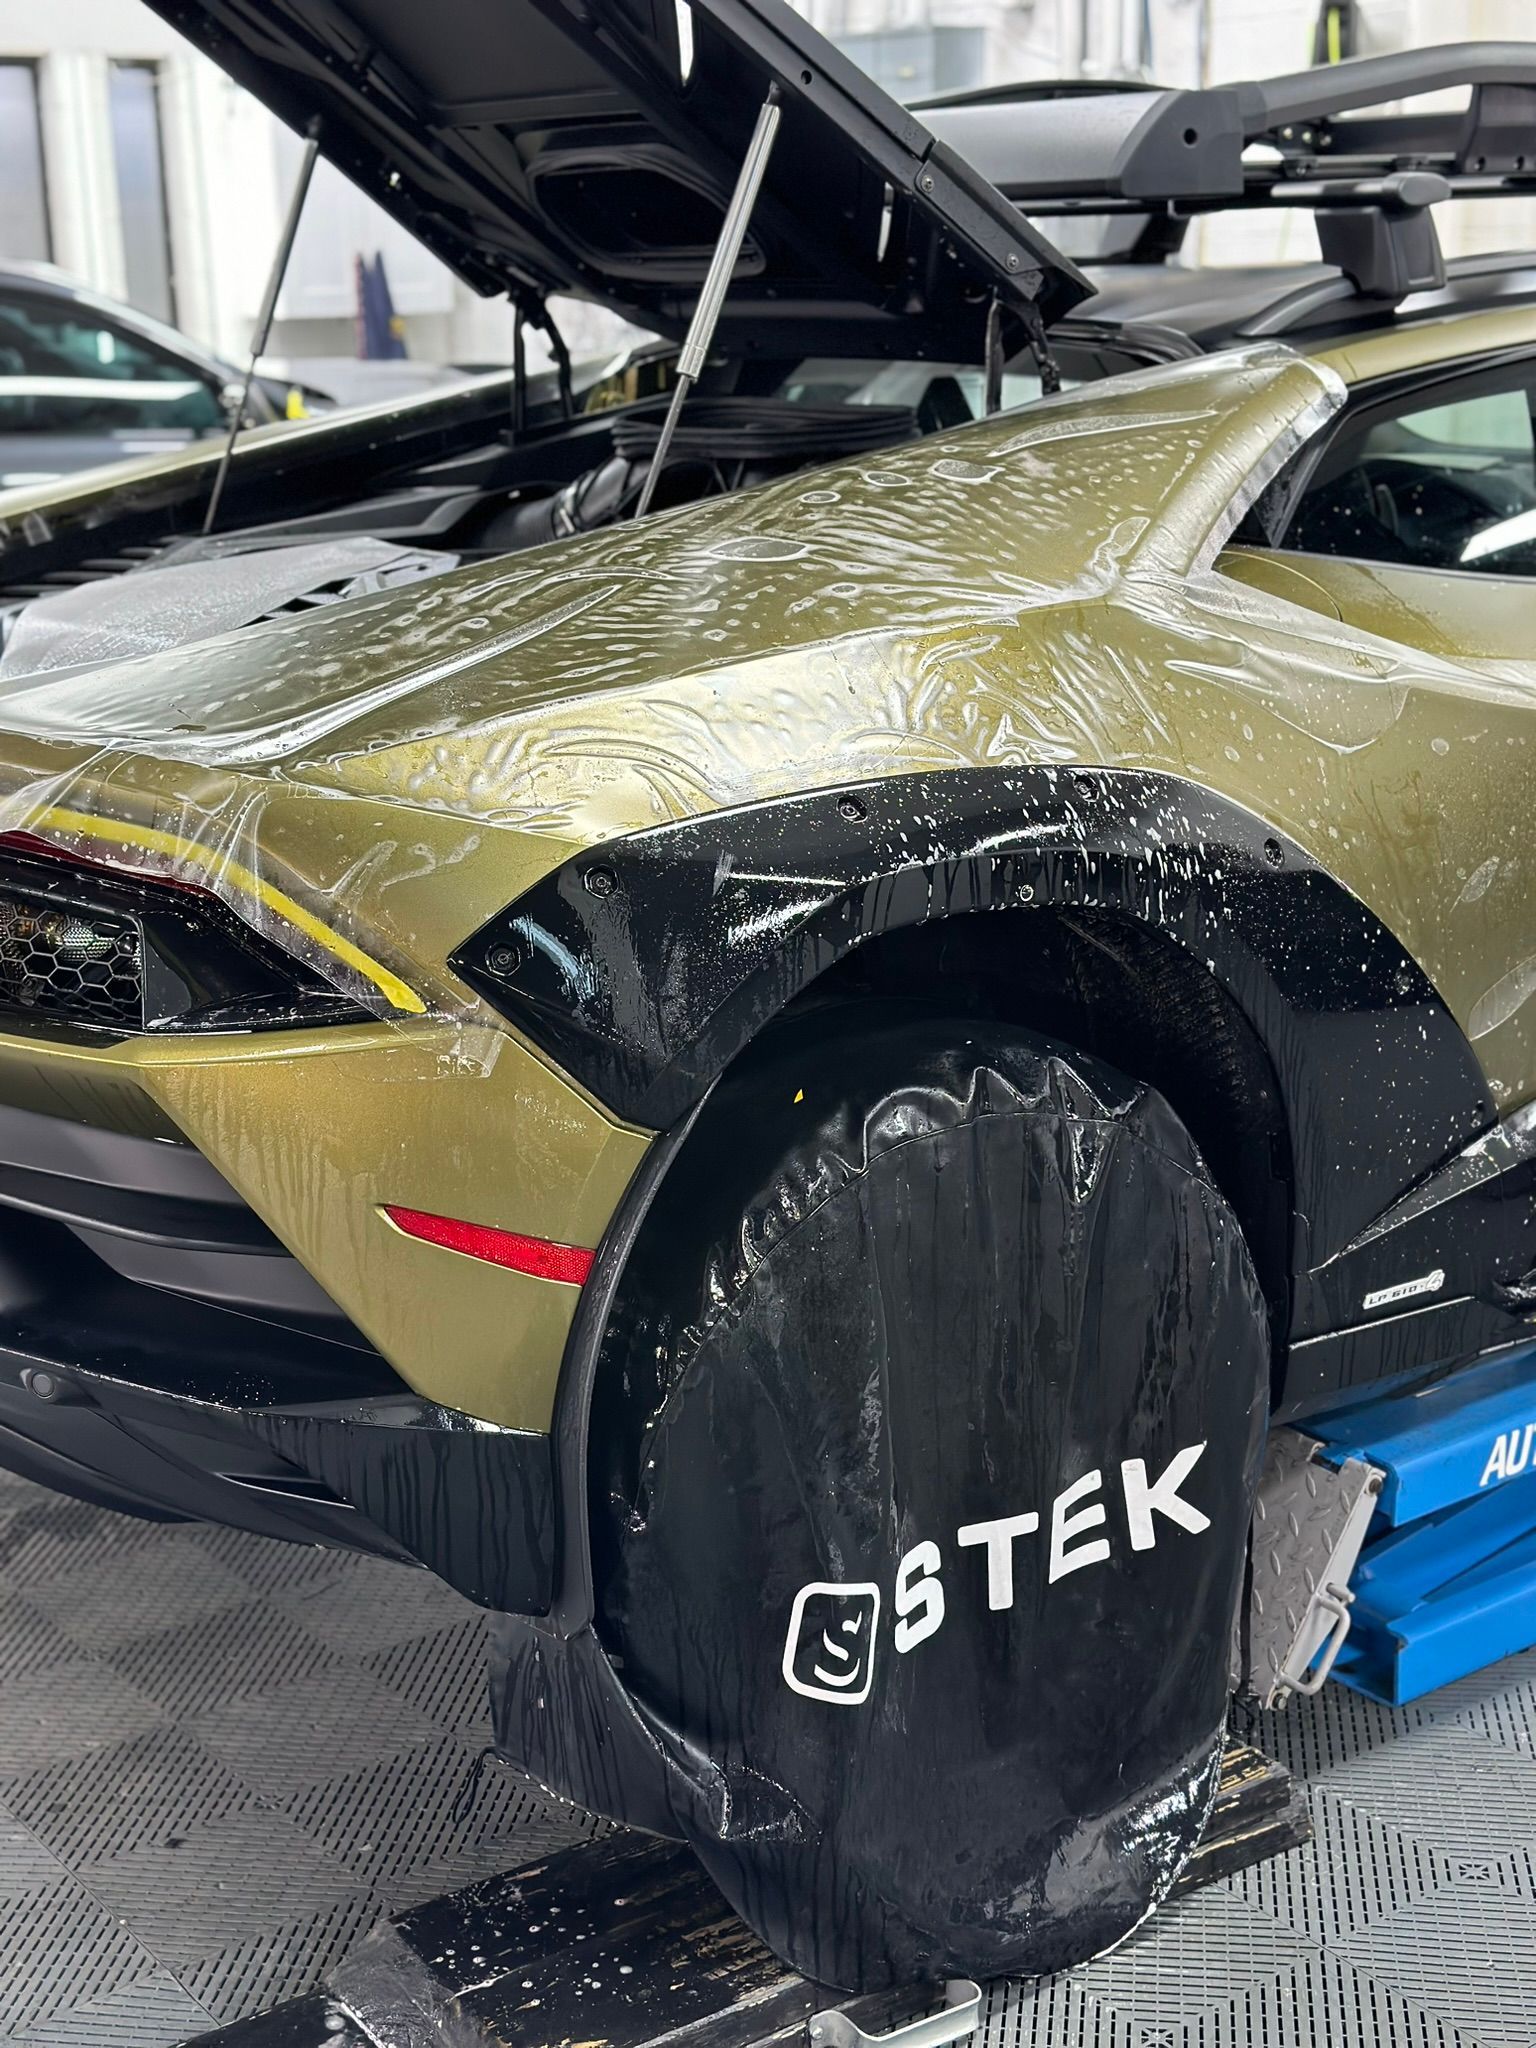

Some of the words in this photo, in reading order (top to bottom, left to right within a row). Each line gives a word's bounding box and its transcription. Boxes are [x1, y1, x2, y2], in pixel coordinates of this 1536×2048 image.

[1369, 1294, 1387, 1305] LP
[1480, 1423, 1536, 1487] AU
[895, 1440, 1211, 1654] STEK
